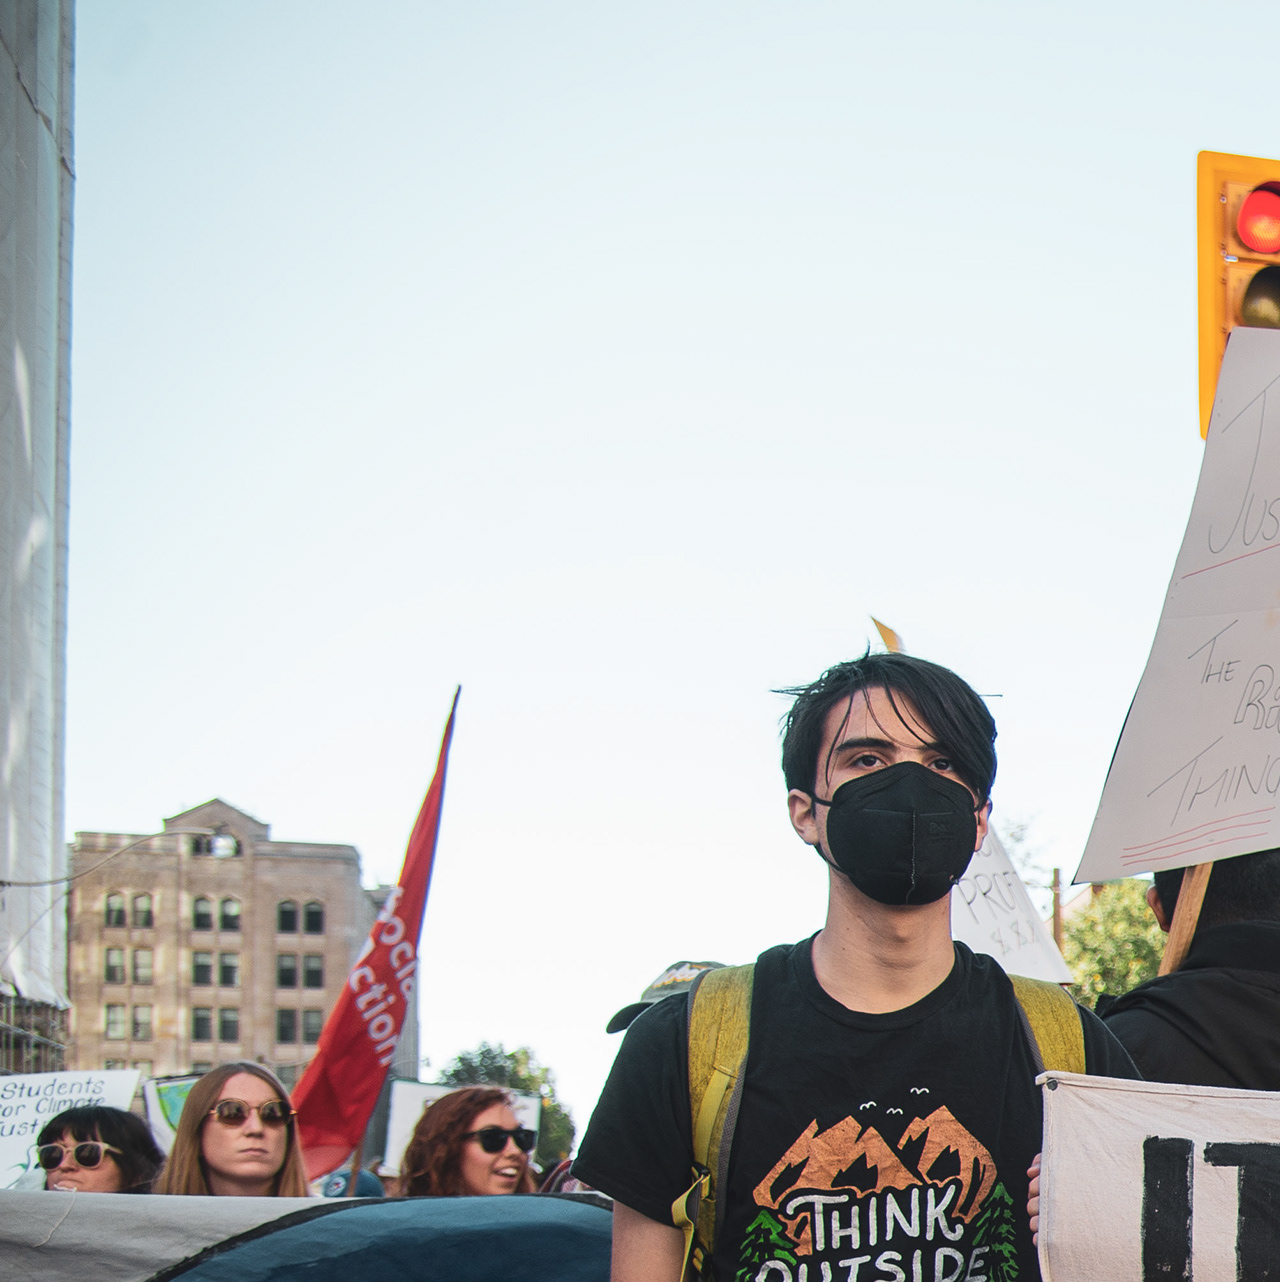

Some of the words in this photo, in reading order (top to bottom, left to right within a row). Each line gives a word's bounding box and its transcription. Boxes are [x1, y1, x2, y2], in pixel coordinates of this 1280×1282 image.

[1188, 620, 1241, 684] THE
[349, 940, 399, 1068] ction
[1, 1077, 105, 1100] Students
[0, 1103, 26, 1118] or
[0, 1118, 46, 1138] ust
[786, 1184, 964, 1251] THINK
